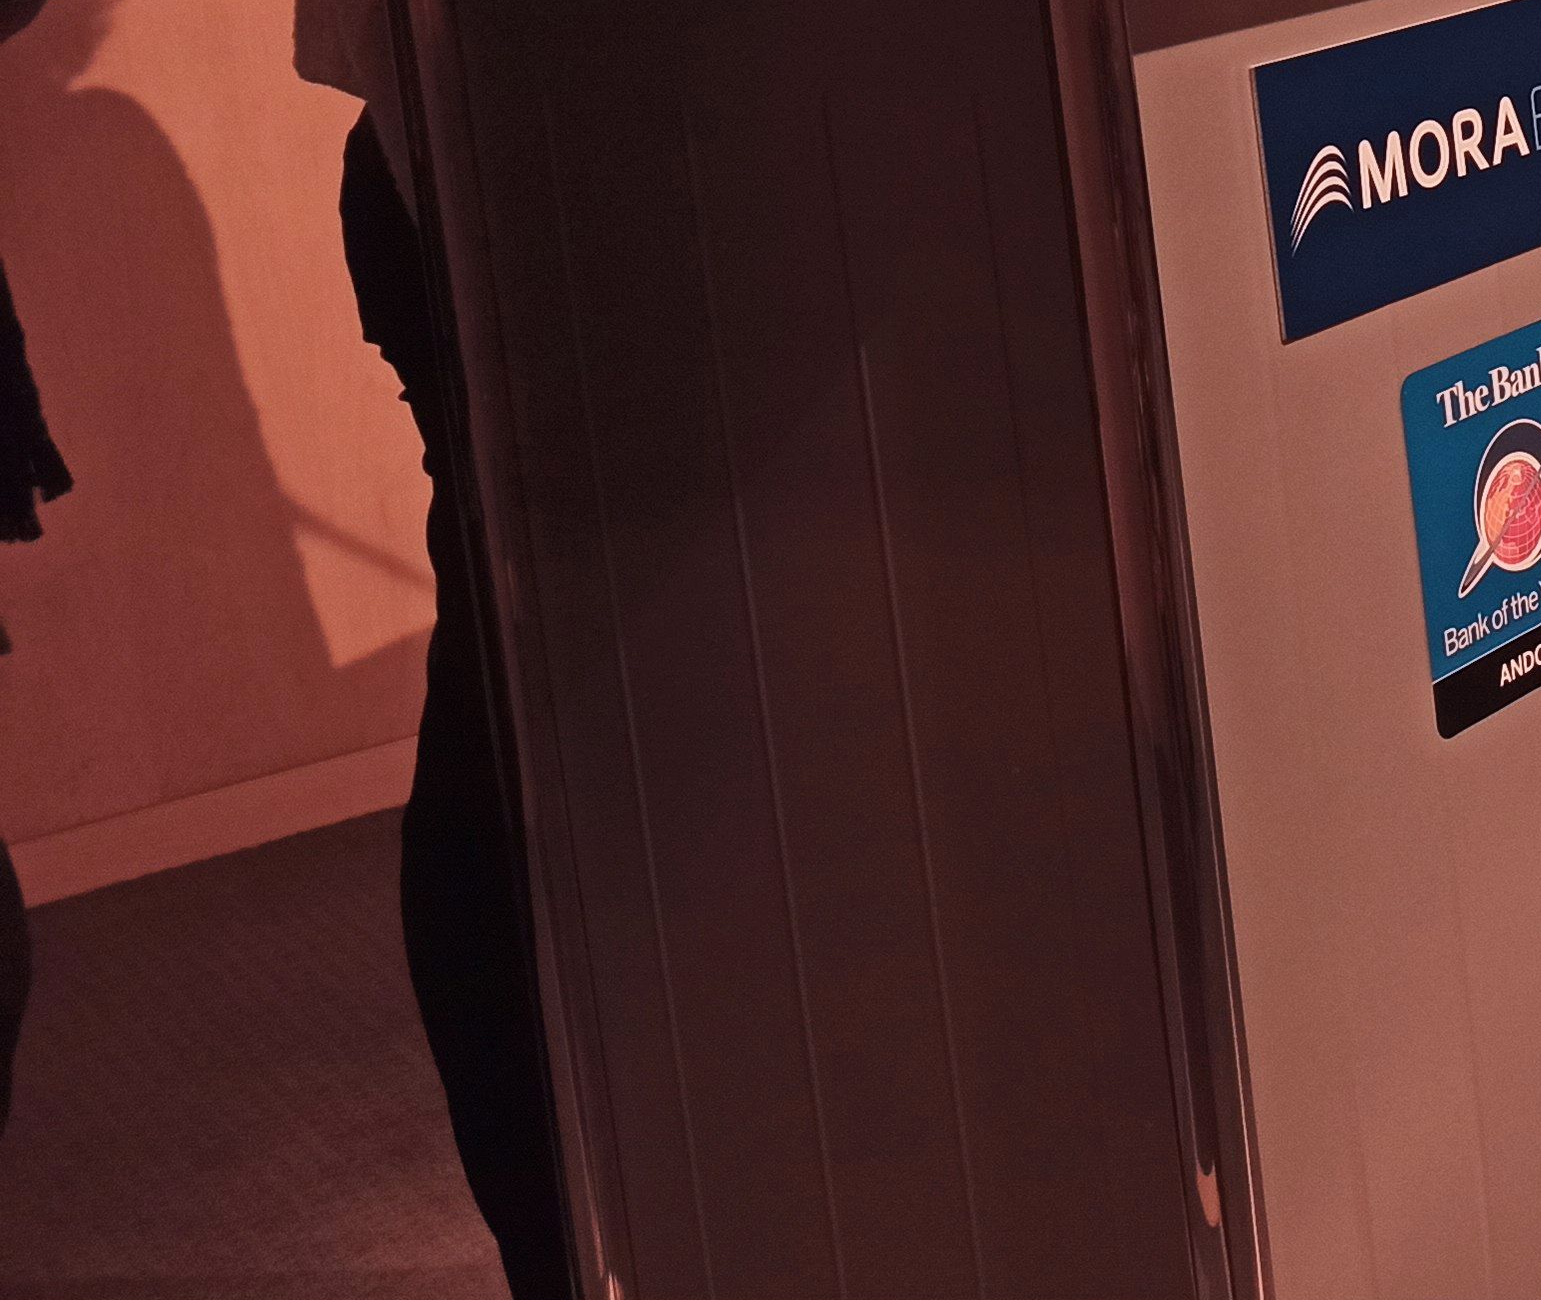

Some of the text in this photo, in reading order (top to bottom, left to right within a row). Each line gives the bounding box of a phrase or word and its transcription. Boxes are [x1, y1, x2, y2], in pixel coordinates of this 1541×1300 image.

[1436, 380, 1490, 429] The
[1444, 611, 1490, 658] Bank
[1491, 598, 1513, 632] of
[1510, 586, 1539, 621] the
